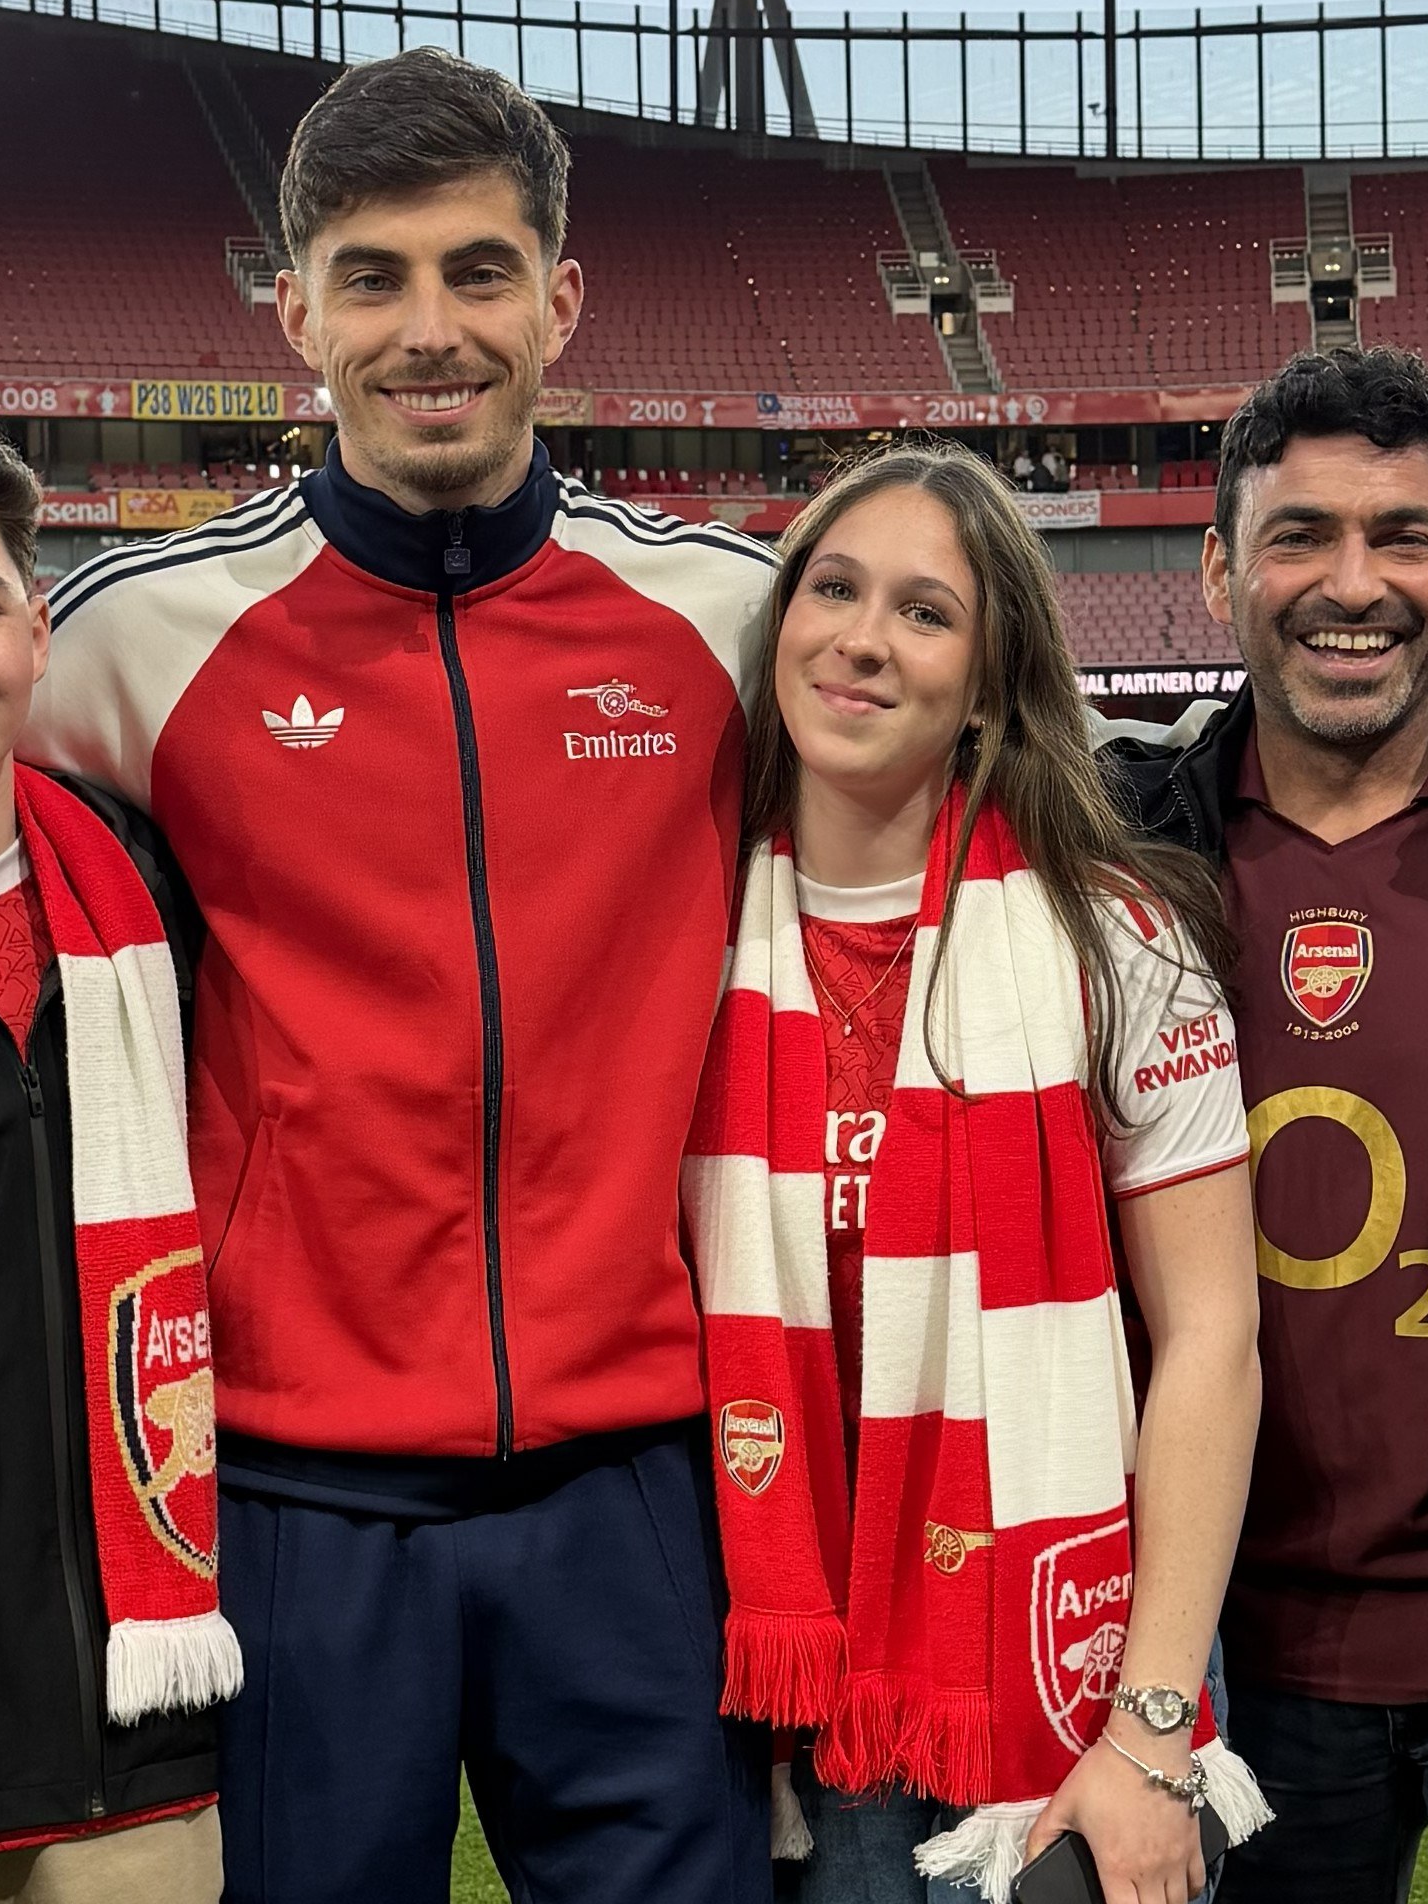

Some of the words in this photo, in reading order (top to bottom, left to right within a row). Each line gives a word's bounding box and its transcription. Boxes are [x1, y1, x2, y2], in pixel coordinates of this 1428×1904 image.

[136, 384, 172, 415] P38
[176, 385, 216, 415] W26
[222, 386, 253, 416] D12
[628, 399, 688, 423] 2010
[925, 399, 976, 423] 2011
[1110, 672, 1193, 695] PARTNER
[1195, 670, 1220, 693] OF
[562, 730, 677, 760] Emirates
[1289, 907, 1369, 923] HIGHBURY
[1295, 943, 1358, 958] Arsenal
[1158, 1014, 1221, 1055] VISIT
[1286, 1021, 1360, 1041] 1913-2006
[144, 1308, 211, 1371] Arse
[1055, 1571, 1132, 1620] Arsen
